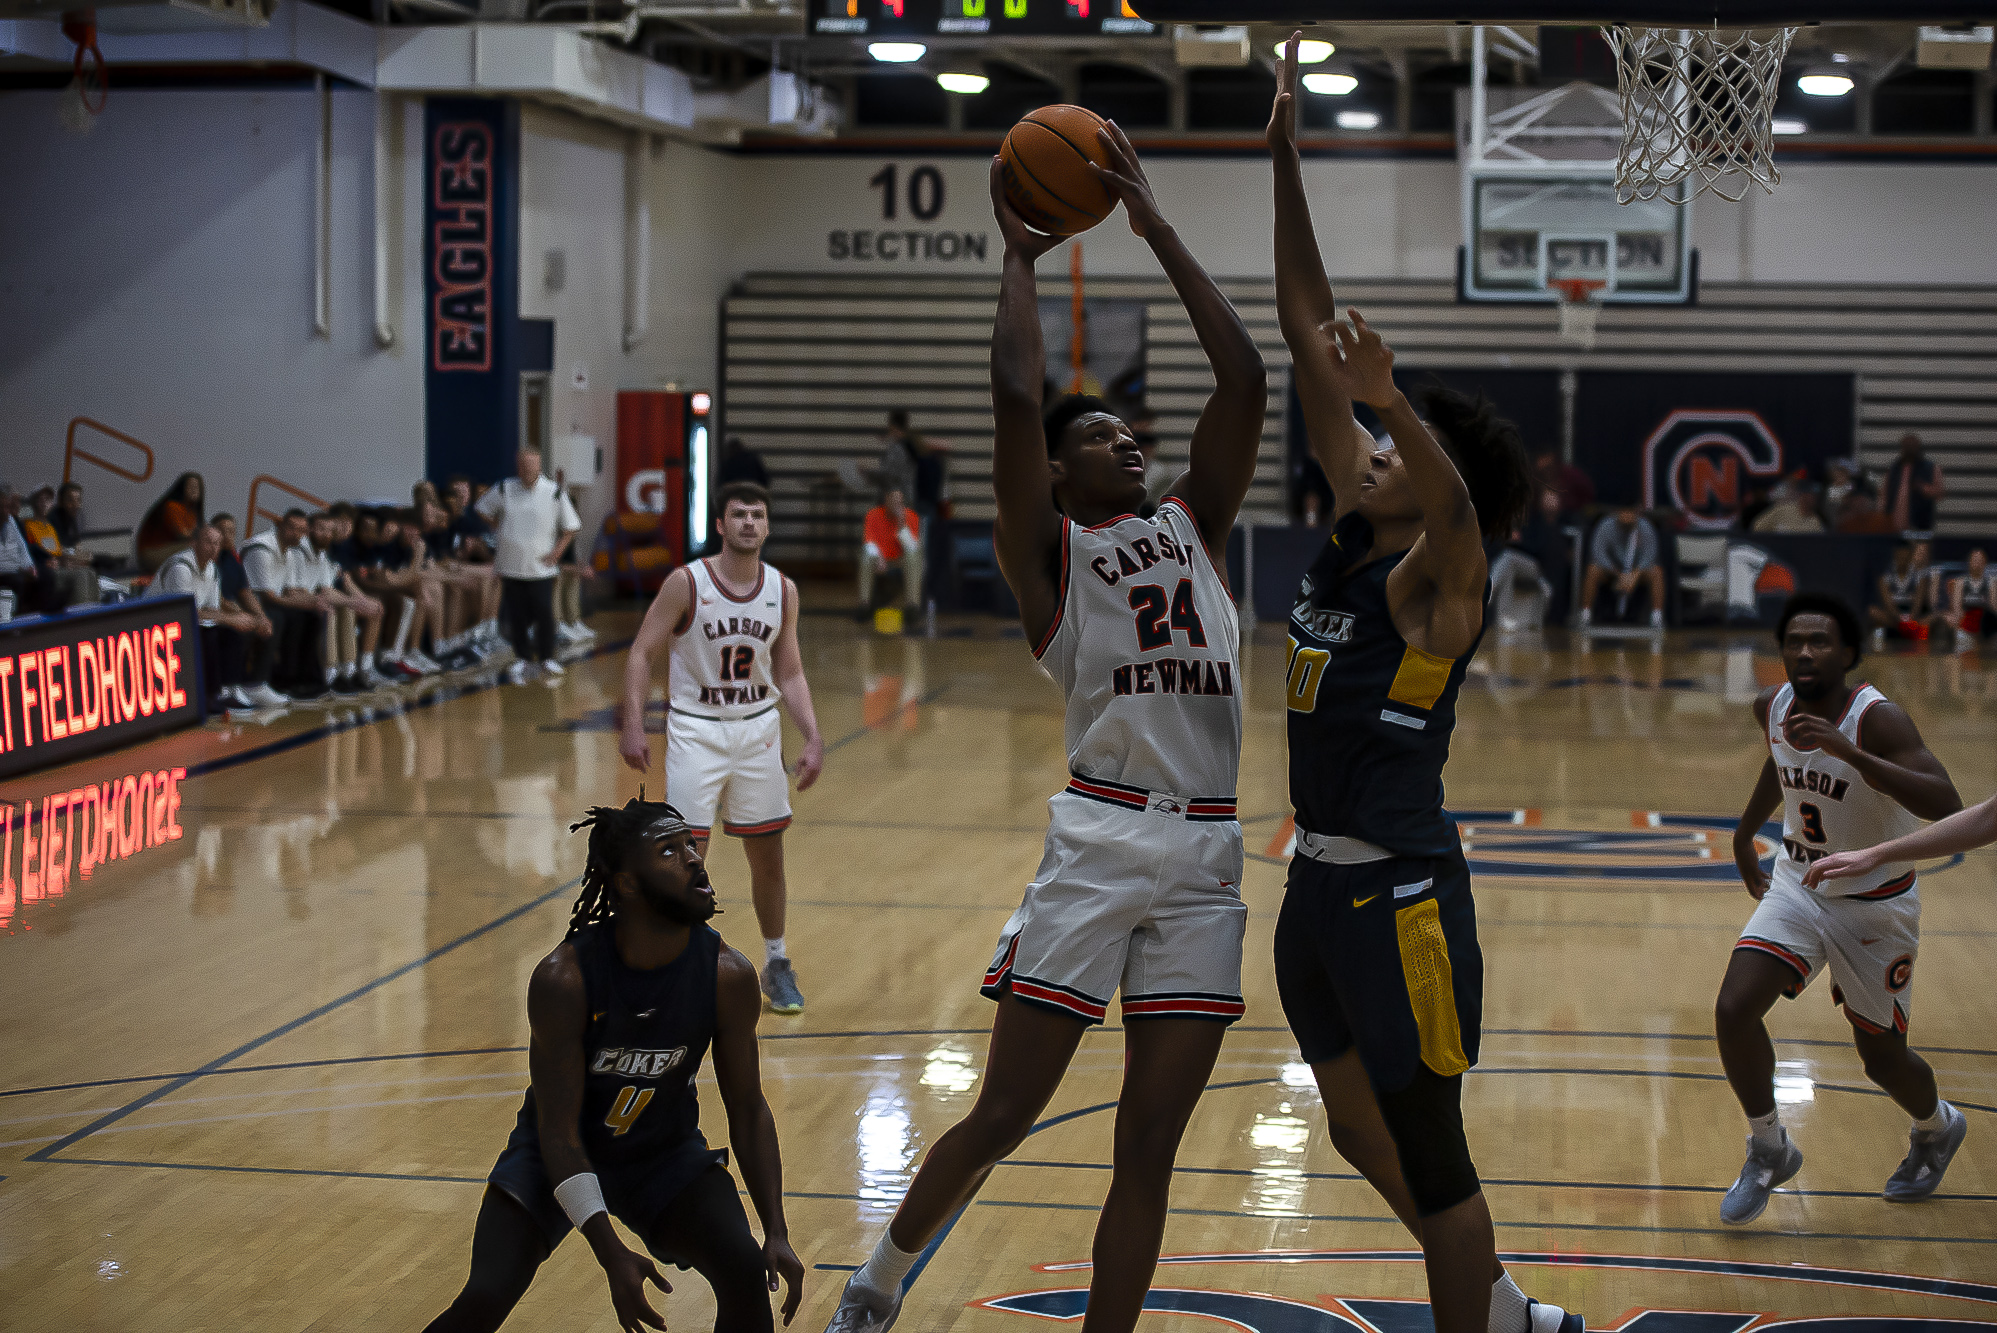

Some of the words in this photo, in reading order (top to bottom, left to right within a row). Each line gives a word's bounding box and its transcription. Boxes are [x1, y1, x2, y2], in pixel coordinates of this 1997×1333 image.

[870, 163, 945, 220] 10
[434, 122, 492, 371] EAGLES
[828, 229, 988, 262] SECTION
[625, 469, 668, 515] G
[703, 616, 773, 641] CARSON
[1128, 577, 1208, 652] 24
[18, 621, 187, 747] FIELDHOUSE
[720, 644, 755, 681] 12
[1112, 657, 1234, 696] NEWMAN
[1799, 801, 1828, 844] 3
[605, 1086, 656, 1136] 4
